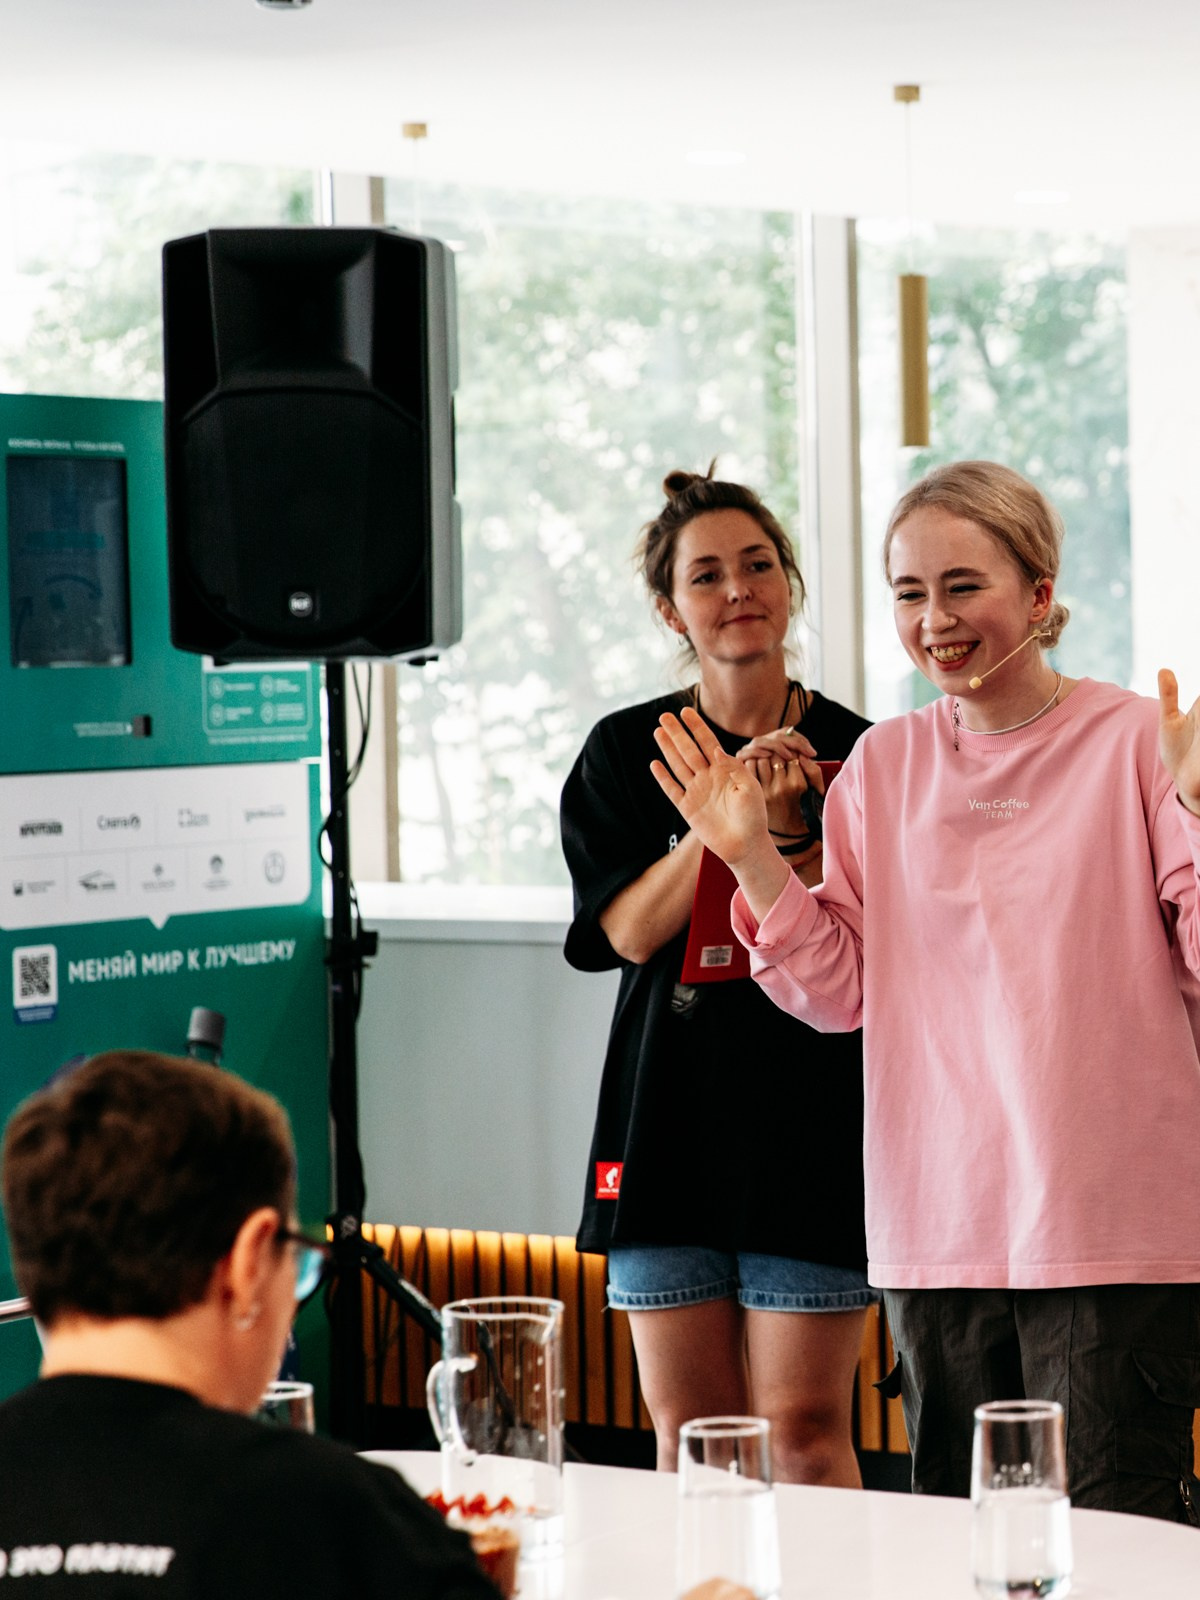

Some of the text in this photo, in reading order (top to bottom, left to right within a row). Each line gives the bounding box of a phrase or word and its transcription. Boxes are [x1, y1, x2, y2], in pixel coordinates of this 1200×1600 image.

[968, 799, 1029, 811] Van Coffee
[984, 810, 1013, 819] TEAM
[68, 938, 296, 984] МЕНЯЙ МИР К ЛУЧШЕМУ
